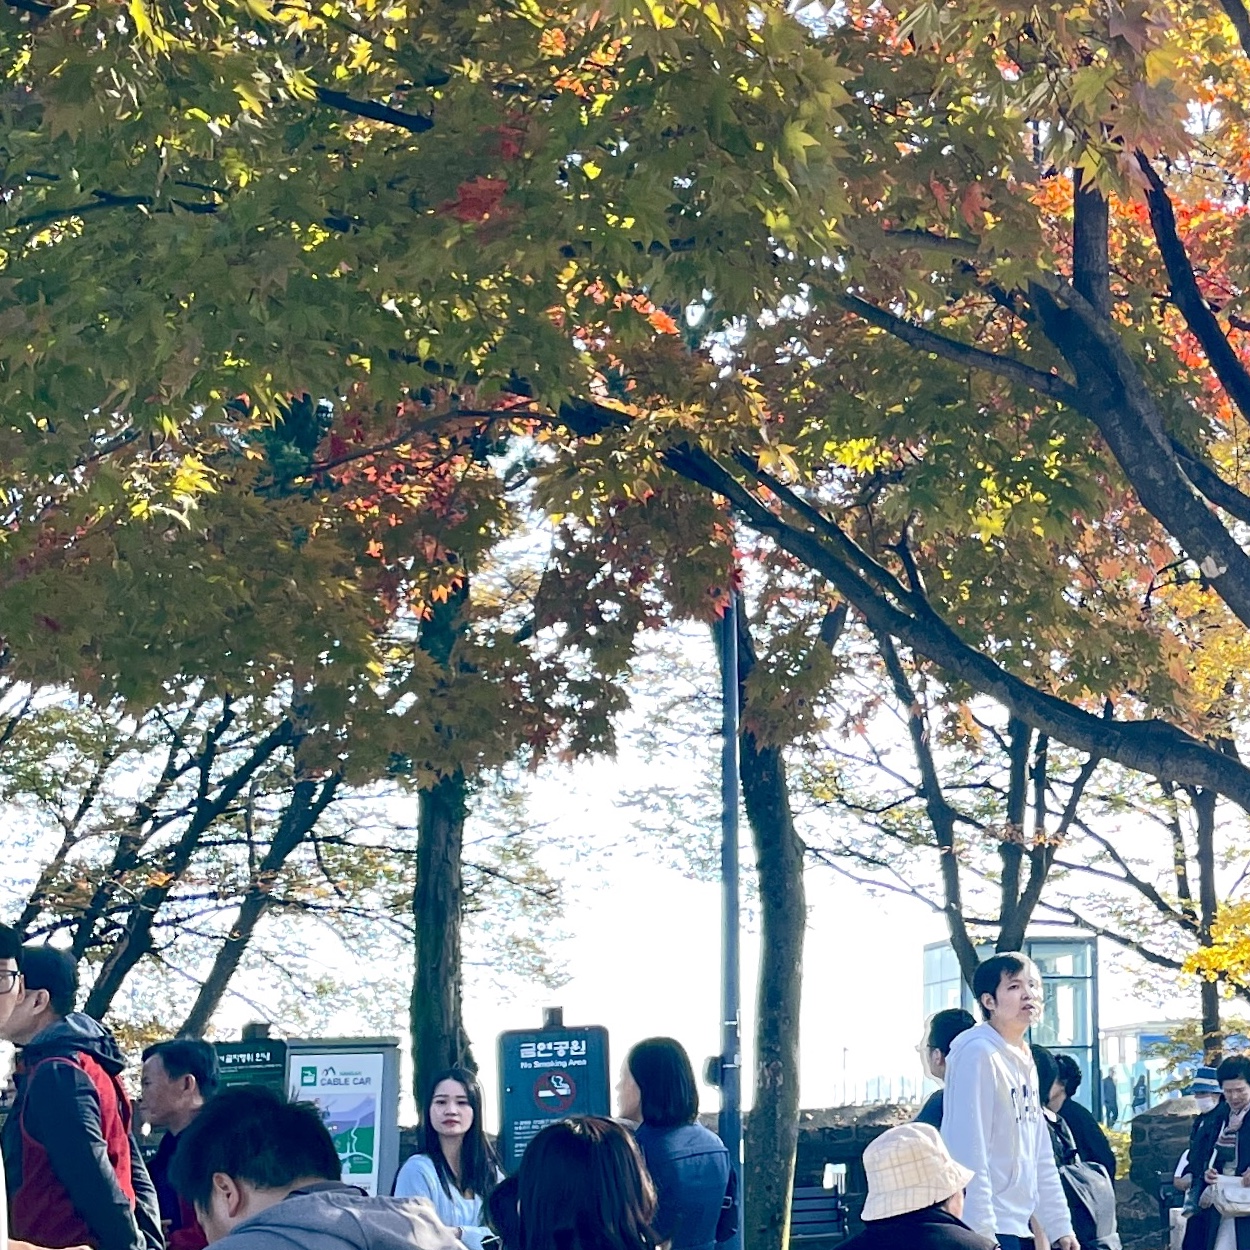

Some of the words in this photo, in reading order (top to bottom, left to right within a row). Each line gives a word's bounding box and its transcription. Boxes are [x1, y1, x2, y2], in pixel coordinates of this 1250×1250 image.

[520, 1040, 586, 1058] 금연공원
[533, 1060, 567, 1069] Smoking
[568, 1059, 587, 1067] Area
[320, 1077, 350, 1086] CABLE
[352, 1076, 371, 1086] CAR
